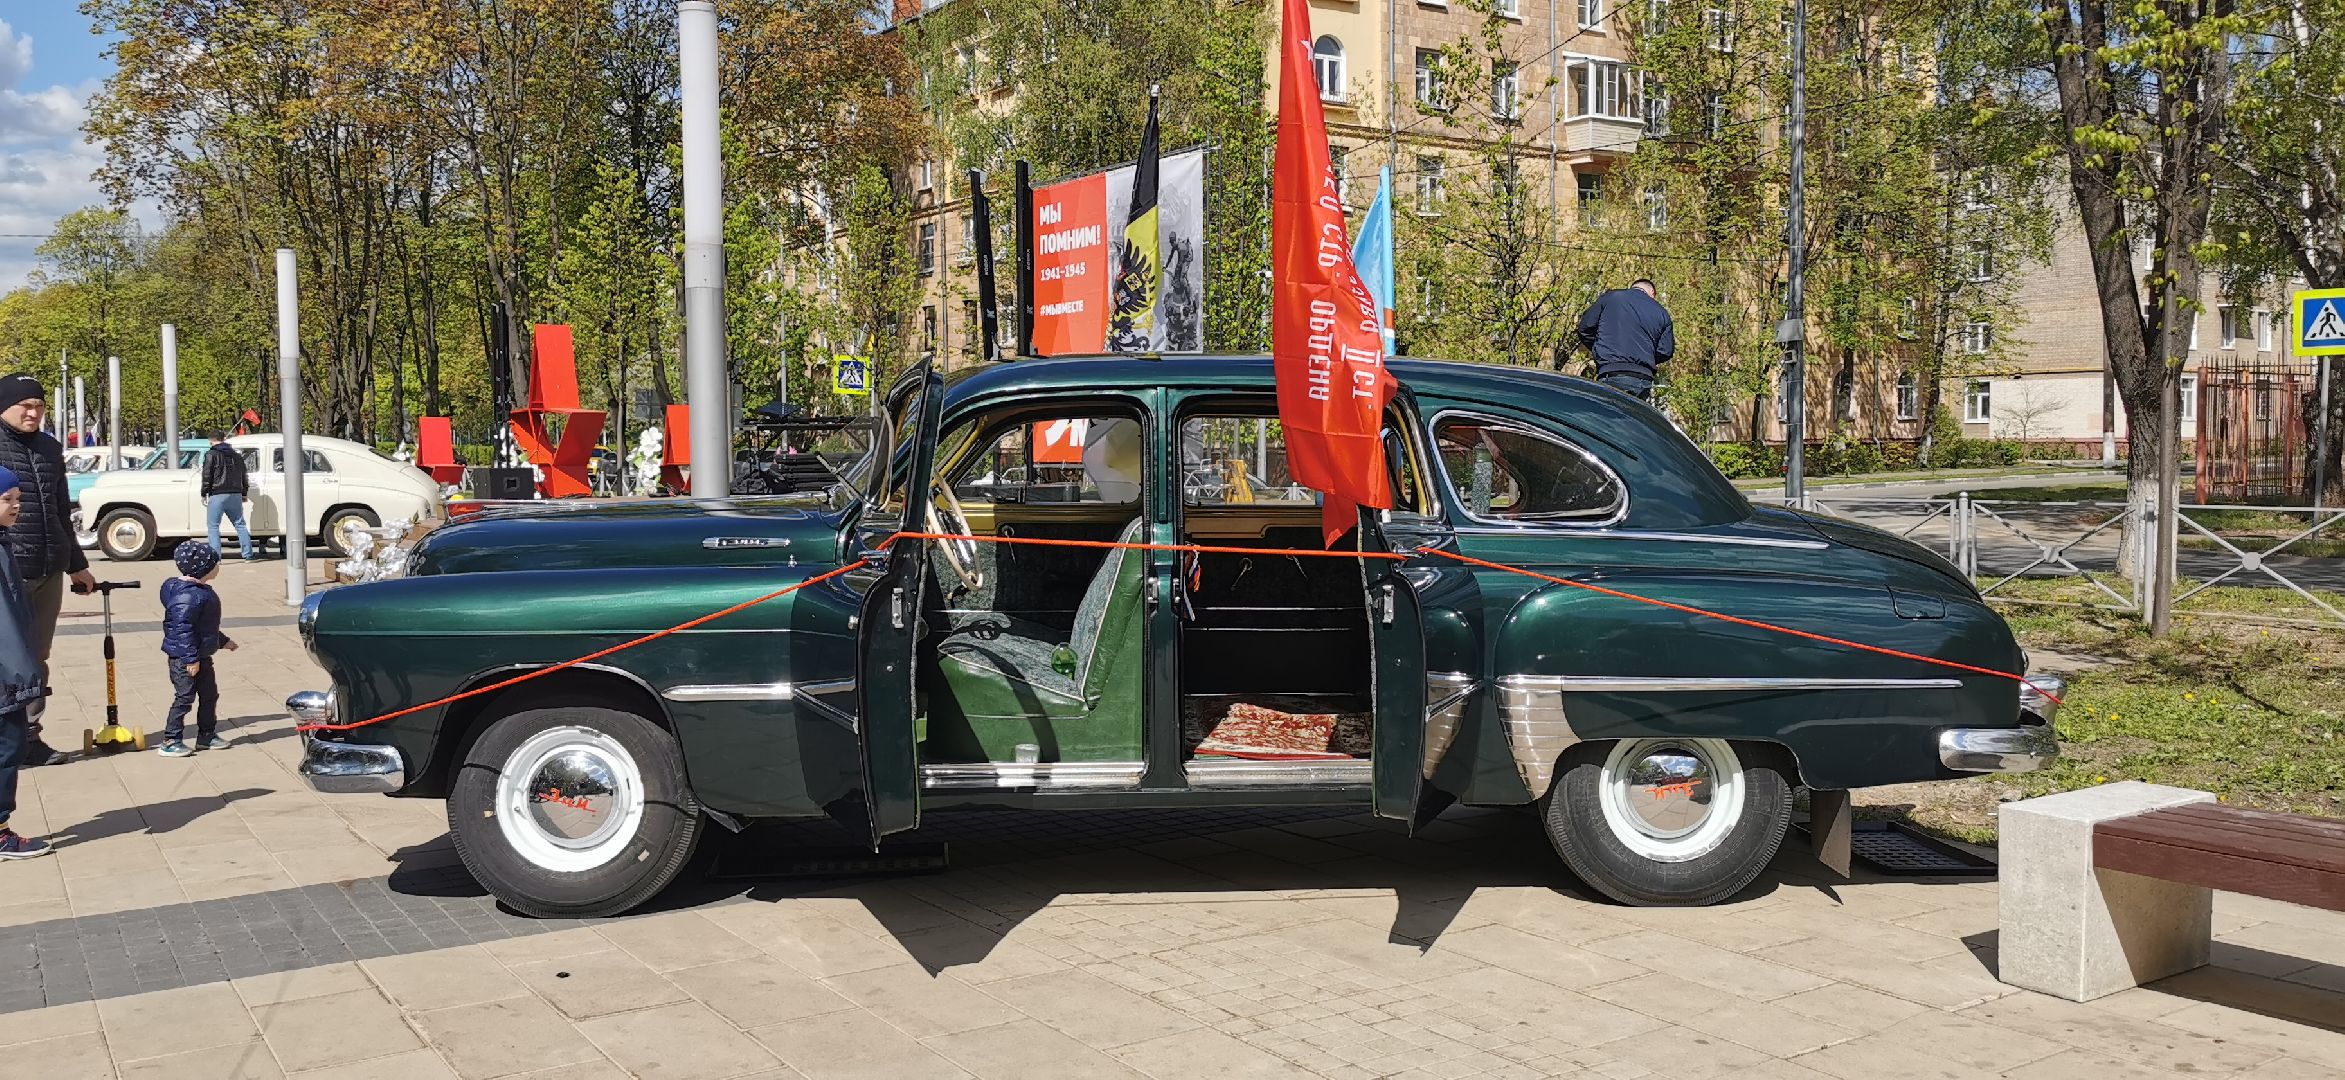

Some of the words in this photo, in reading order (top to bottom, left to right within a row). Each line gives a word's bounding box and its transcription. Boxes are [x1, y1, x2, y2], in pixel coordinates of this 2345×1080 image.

[1039, 202, 1062, 226] МЫ
[1039, 224, 1101, 255] ПОМНИМ!
[1039, 300, 1084, 317] #МЫВМЕСТЕ
